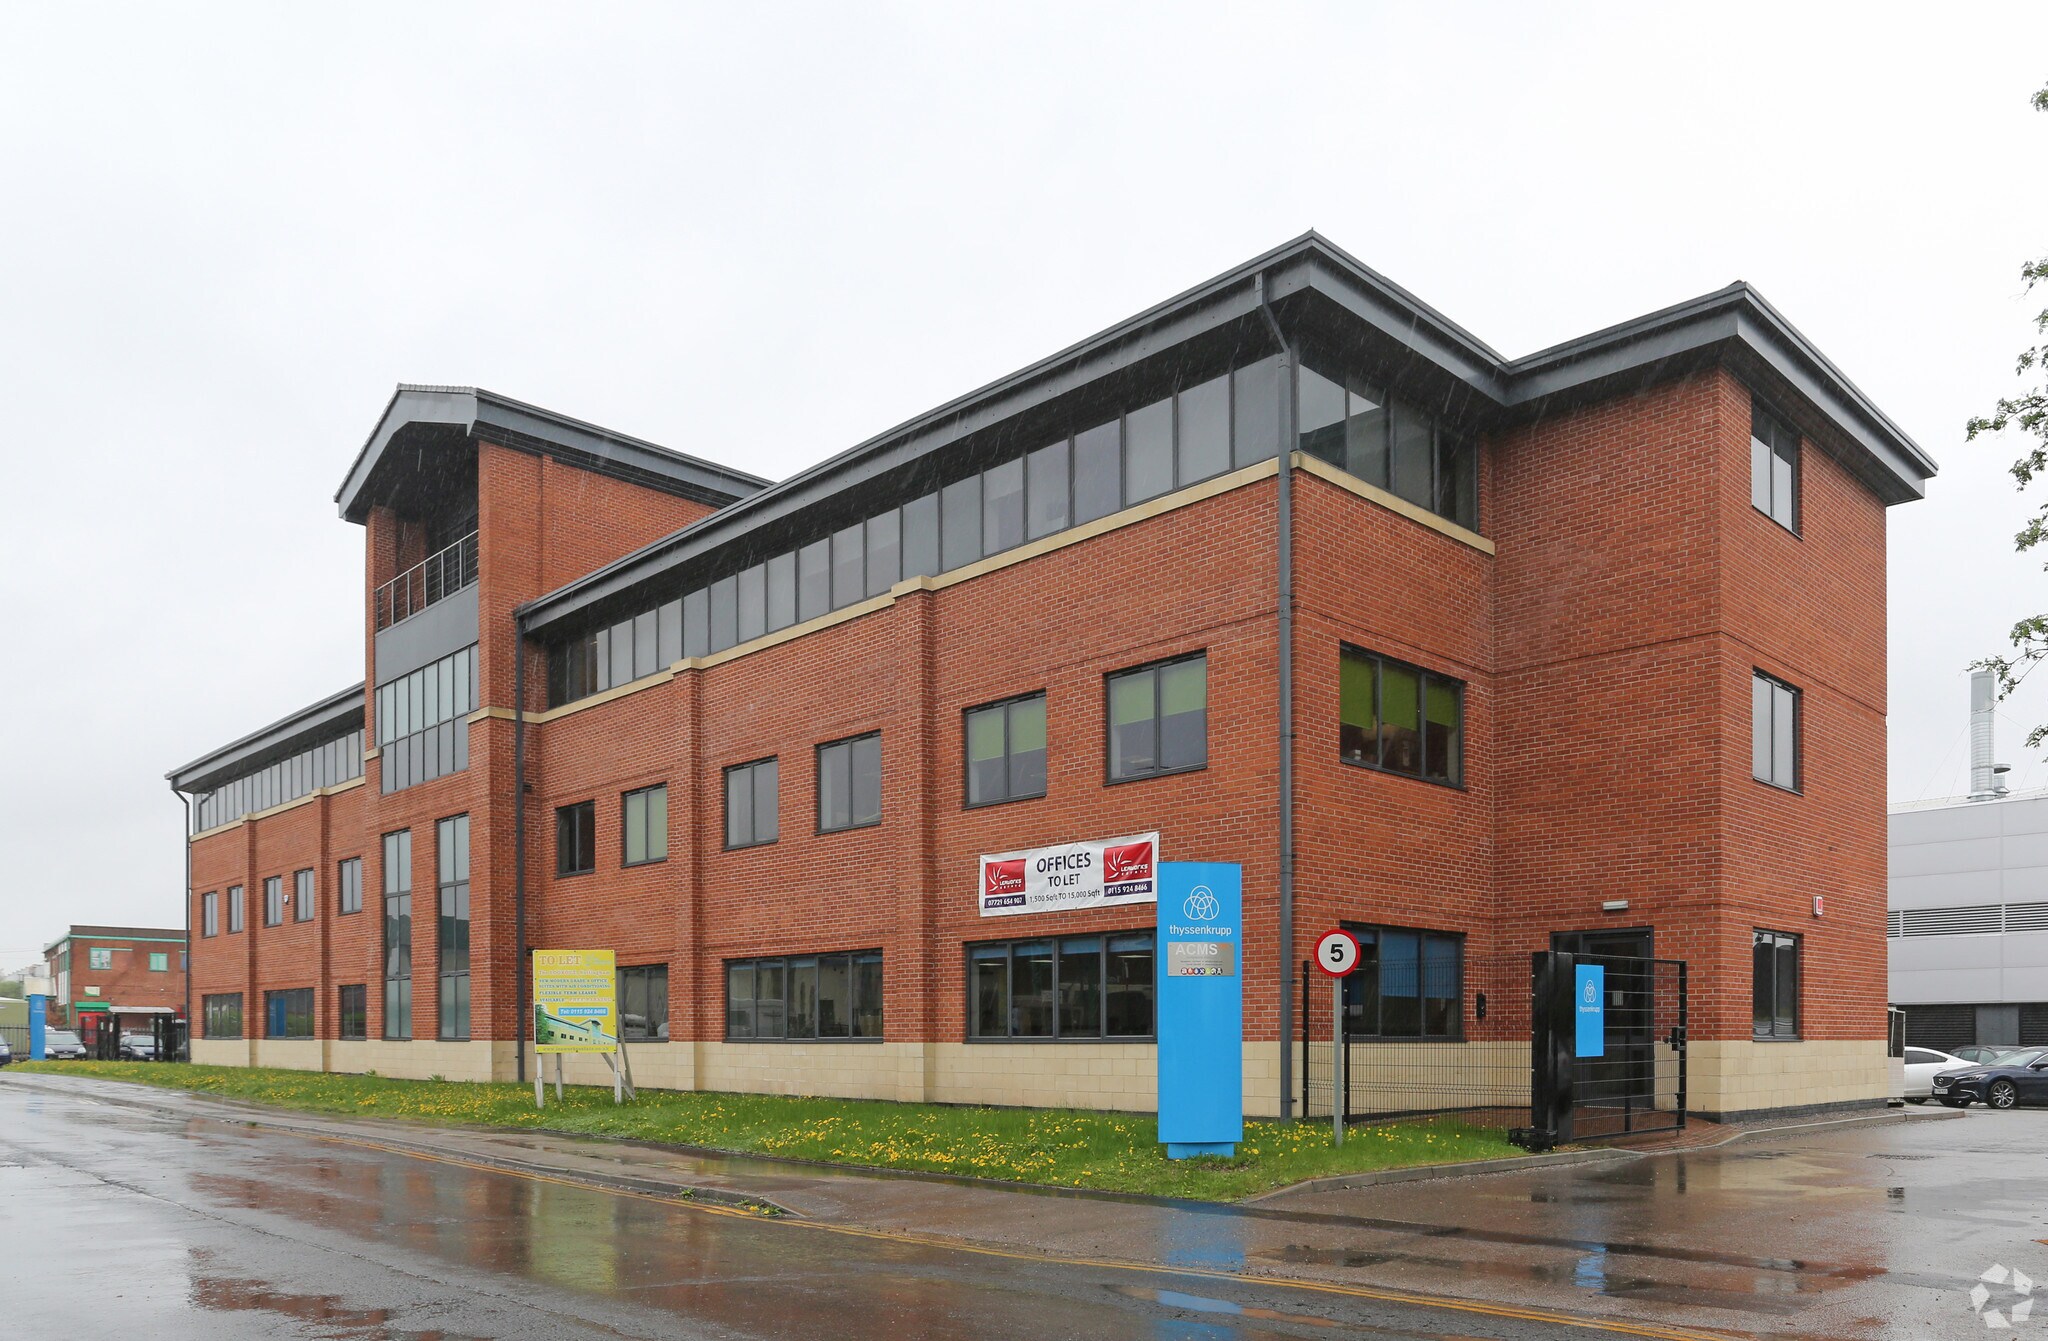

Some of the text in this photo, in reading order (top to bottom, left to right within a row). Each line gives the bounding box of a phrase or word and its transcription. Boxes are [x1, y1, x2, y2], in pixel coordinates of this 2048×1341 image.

[1036, 852, 1091, 873] OFFICES
[1048, 873, 1080, 887] TO LET
[1068, 891, 1086, 899] 15,000
[1087, 889, 1101, 898] Sqft
[1107, 886, 1121, 894] 0115
[1122, 885, 1133, 893] 924
[1169, 924, 1232, 937] thyssenkrupp
[1175, 943, 1218, 956] ACMS
[1330, 943, 1344, 963] 5
[539, 955, 555, 965] TO
[559, 955, 581, 965] LET
